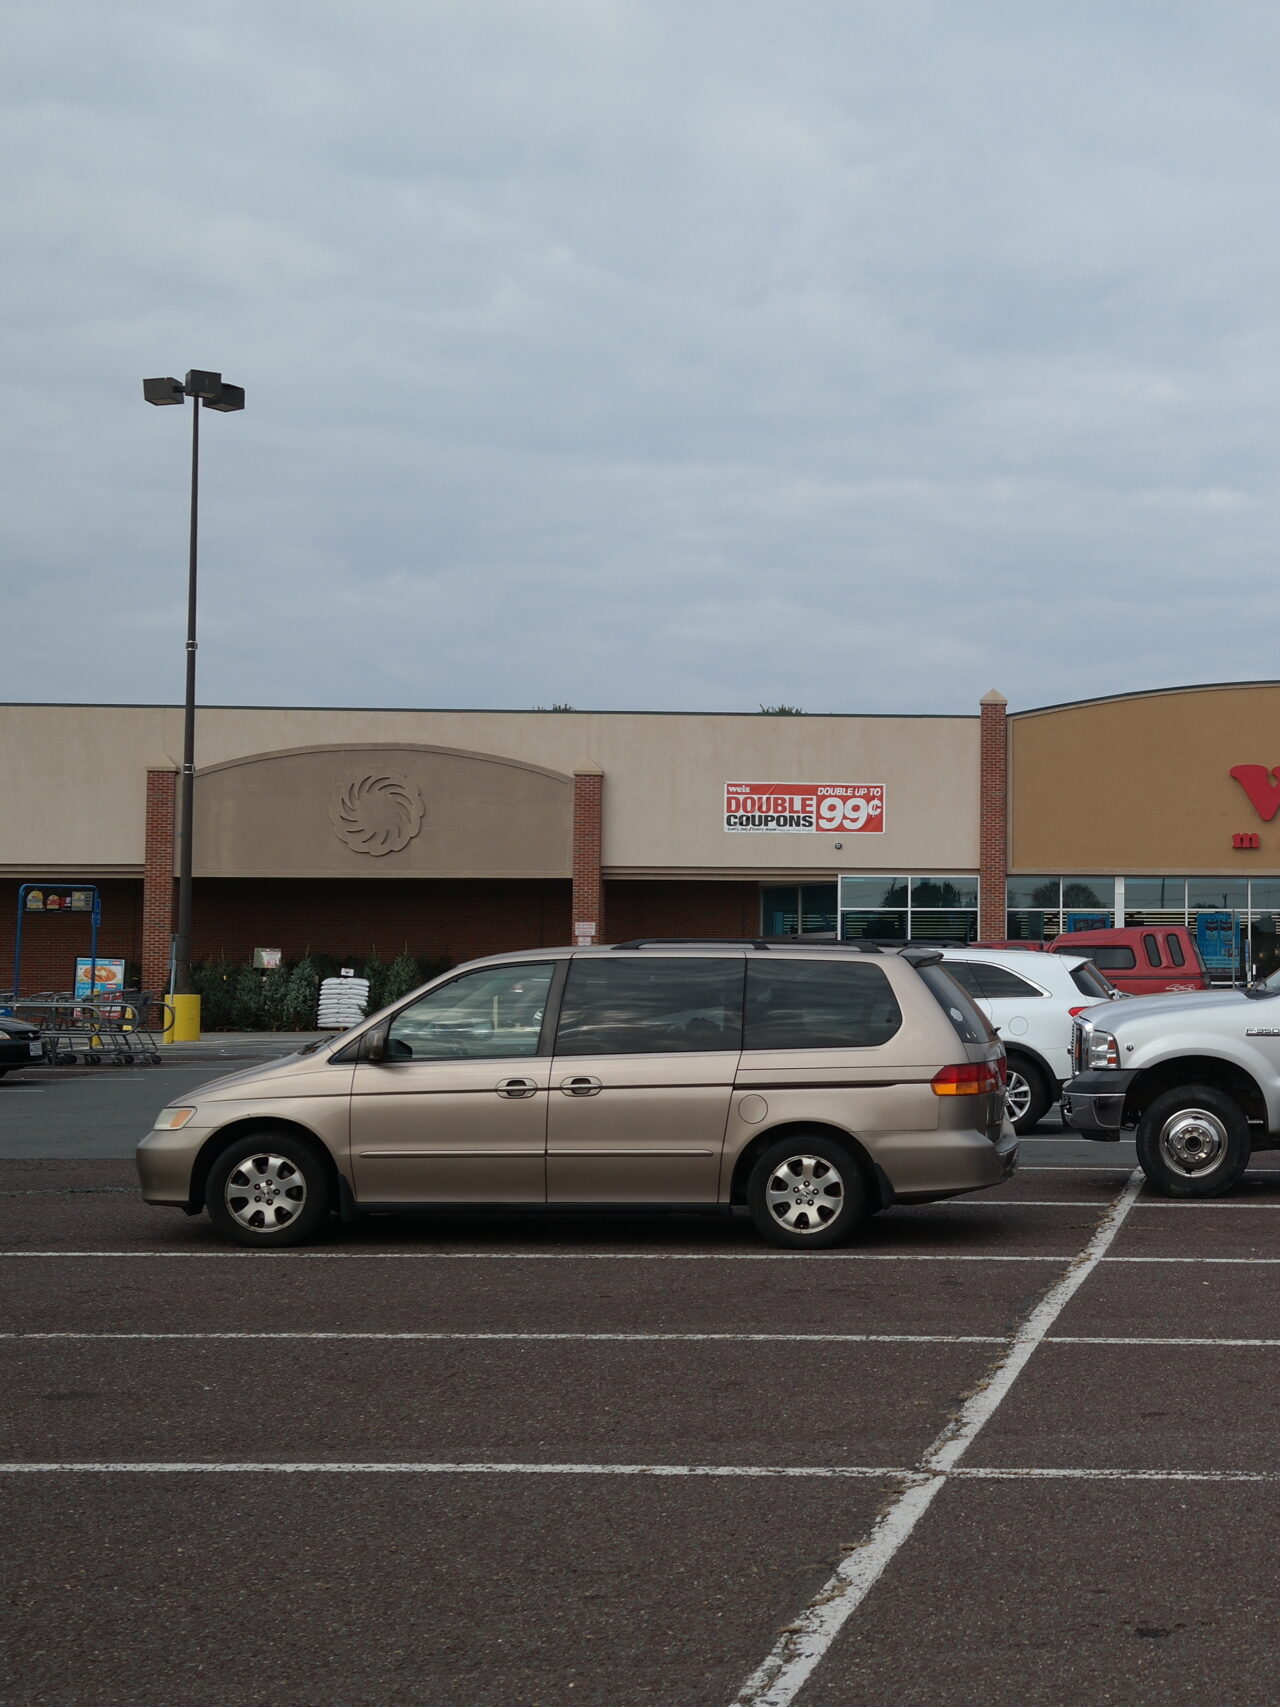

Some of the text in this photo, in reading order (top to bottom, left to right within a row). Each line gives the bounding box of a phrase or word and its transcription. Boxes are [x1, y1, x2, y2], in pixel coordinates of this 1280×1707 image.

[728, 785, 750, 793] weis
[817, 787, 881, 796] DOUBLE UP TO
[726, 796, 814, 814] DOUBLE
[726, 814, 814, 828] COUPONS
